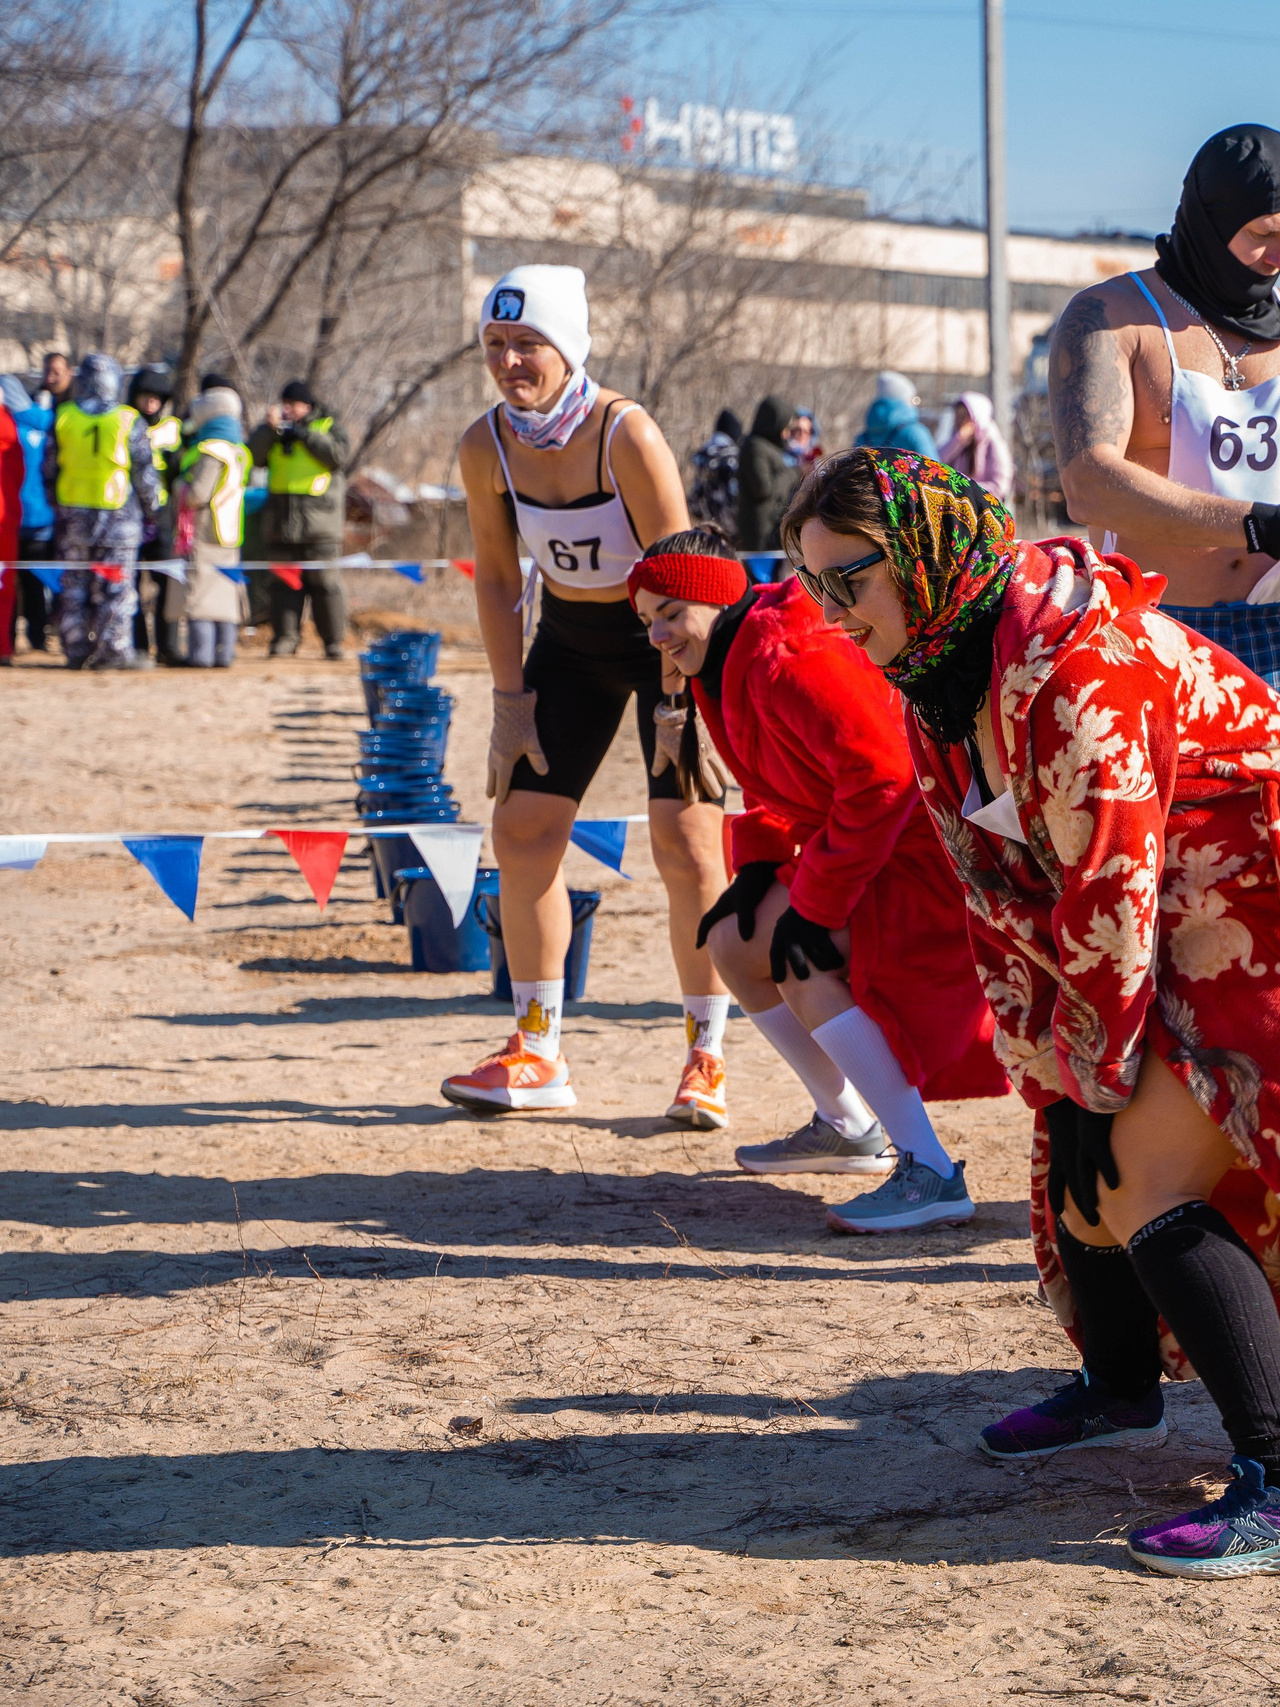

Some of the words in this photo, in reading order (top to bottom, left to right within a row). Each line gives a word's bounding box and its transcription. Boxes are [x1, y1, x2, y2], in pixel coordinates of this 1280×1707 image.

[82, 424, 101, 457] 1
[1210, 415, 1278, 471] 63
[548, 536, 601, 571] 67
